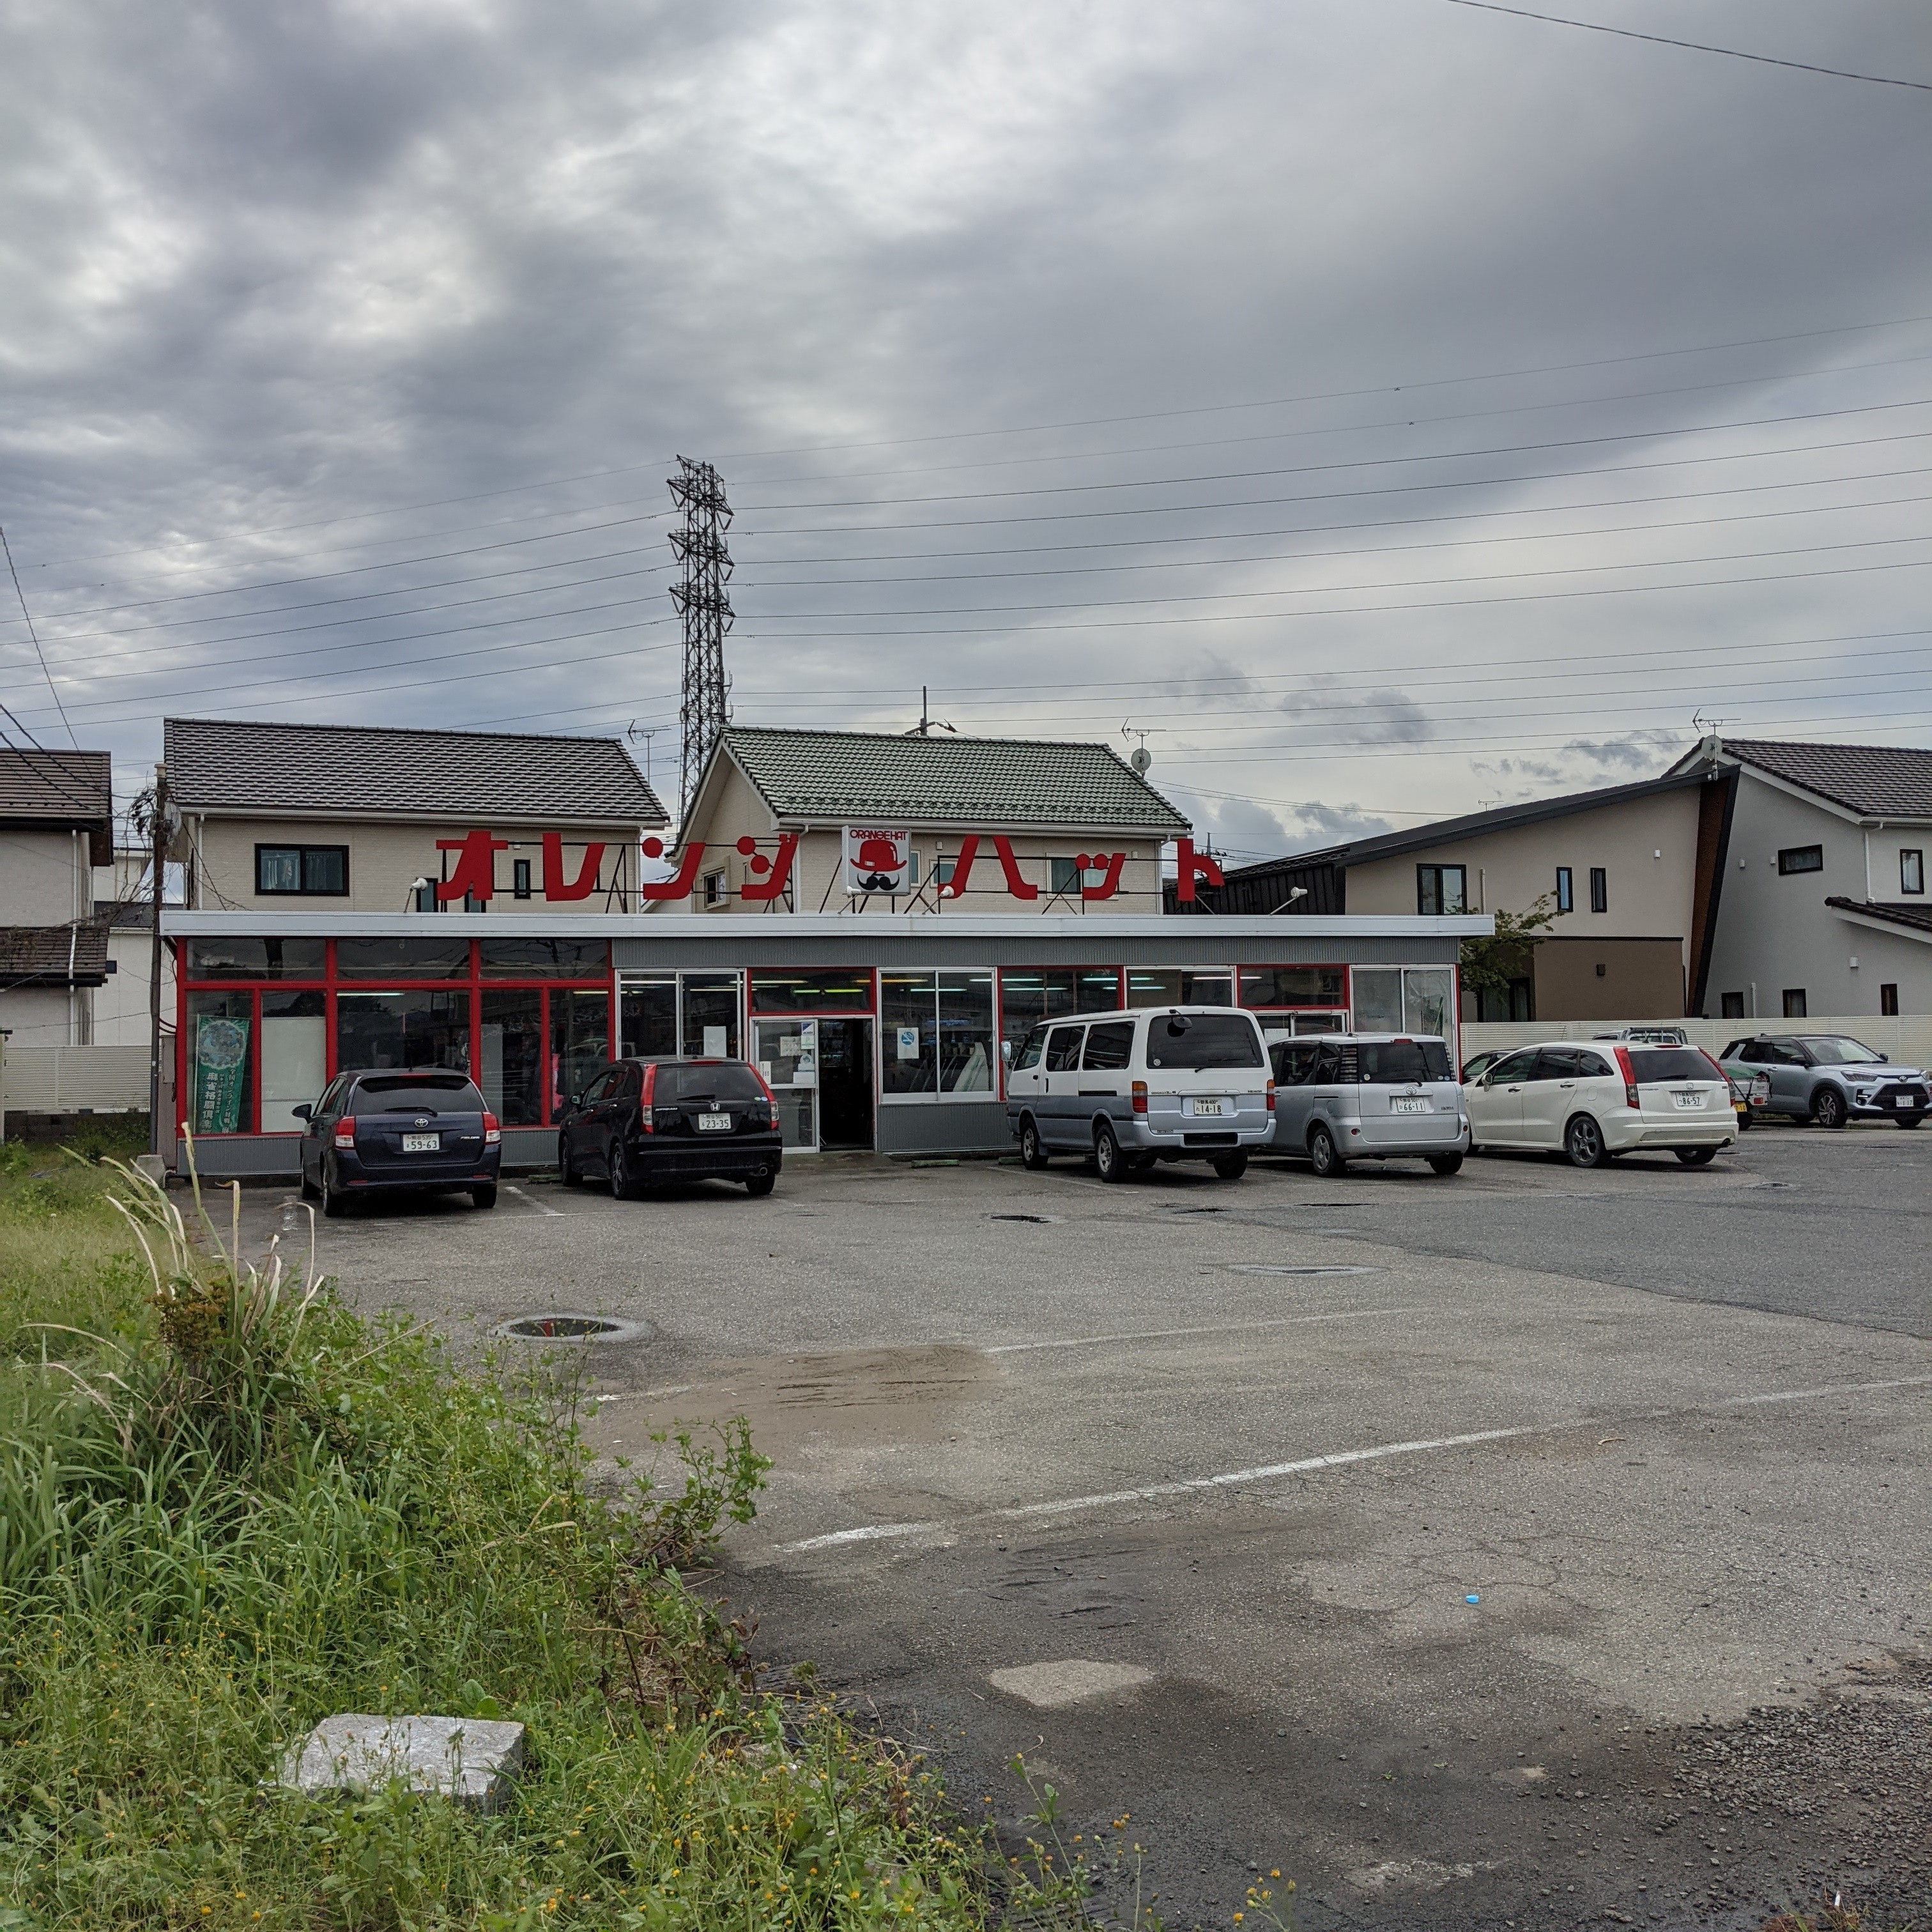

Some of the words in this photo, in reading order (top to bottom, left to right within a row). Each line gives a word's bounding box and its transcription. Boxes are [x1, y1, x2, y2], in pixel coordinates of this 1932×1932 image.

[436, 831, 798, 901] オレンジ
[937, 834, 1225, 901] ハット
[1202, 1105, 1222, 1113] 14-18
[706, 1119, 728, 1128] 23-35
[411, 1140, 437, 1149] 59-63
